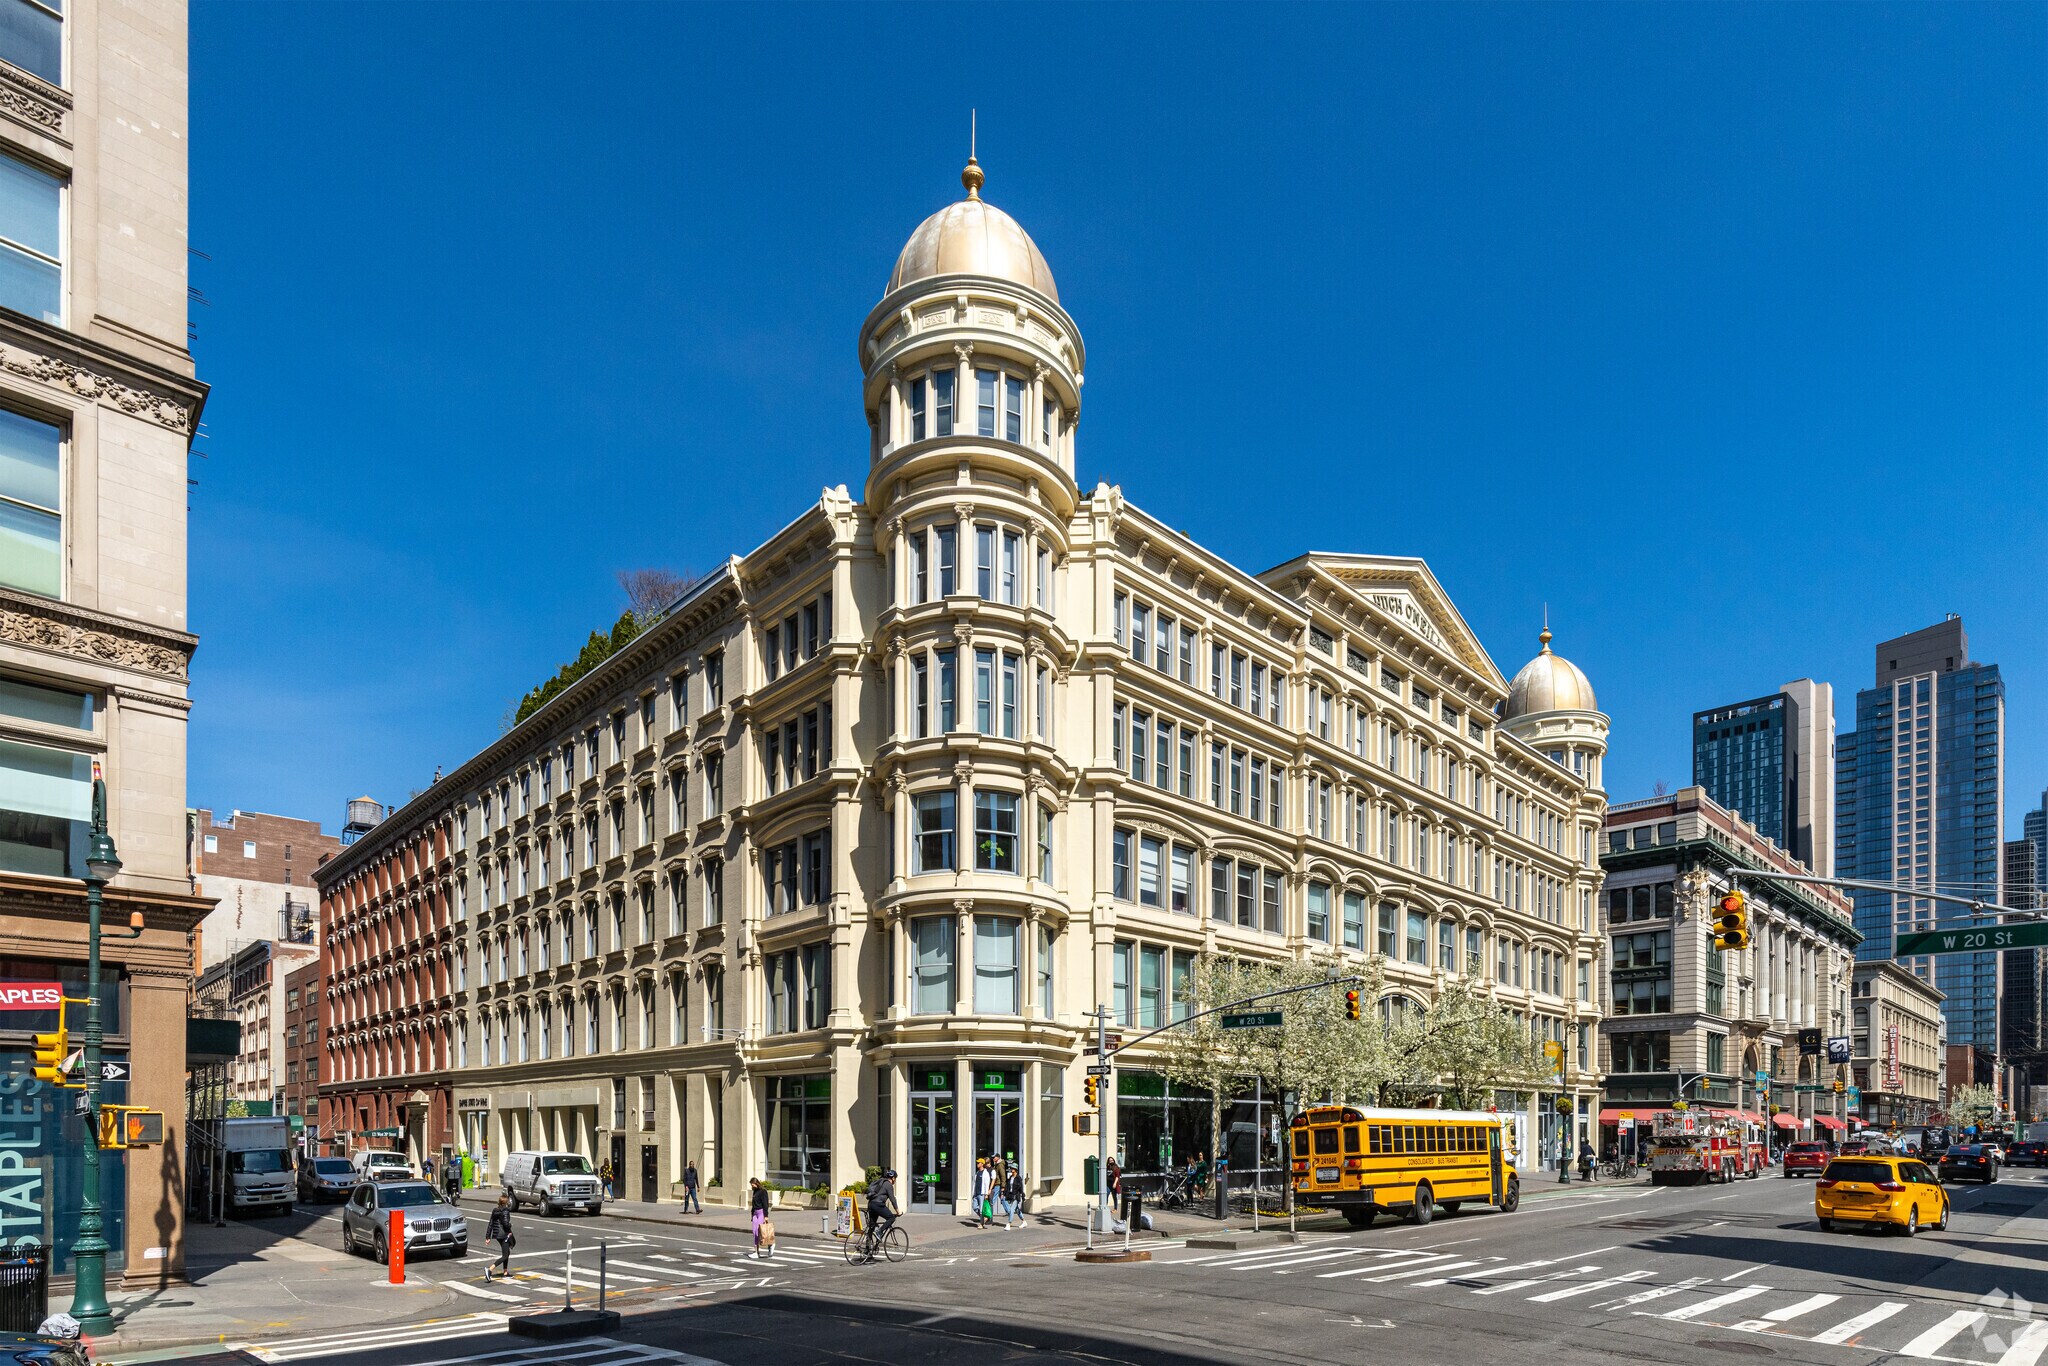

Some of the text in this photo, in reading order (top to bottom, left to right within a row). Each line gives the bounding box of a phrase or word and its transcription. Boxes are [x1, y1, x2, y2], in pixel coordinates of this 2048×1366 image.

[1943, 931, 2013, 949] W 20 St
[1239, 1016, 1265, 1026] W 20 St
[930, 1075, 945, 1086] TD
[986, 1074, 1003, 1086] TD
[1685, 1118, 1694, 1130] 12
[1408, 1158, 1434, 1166] CONSOLIDATED
